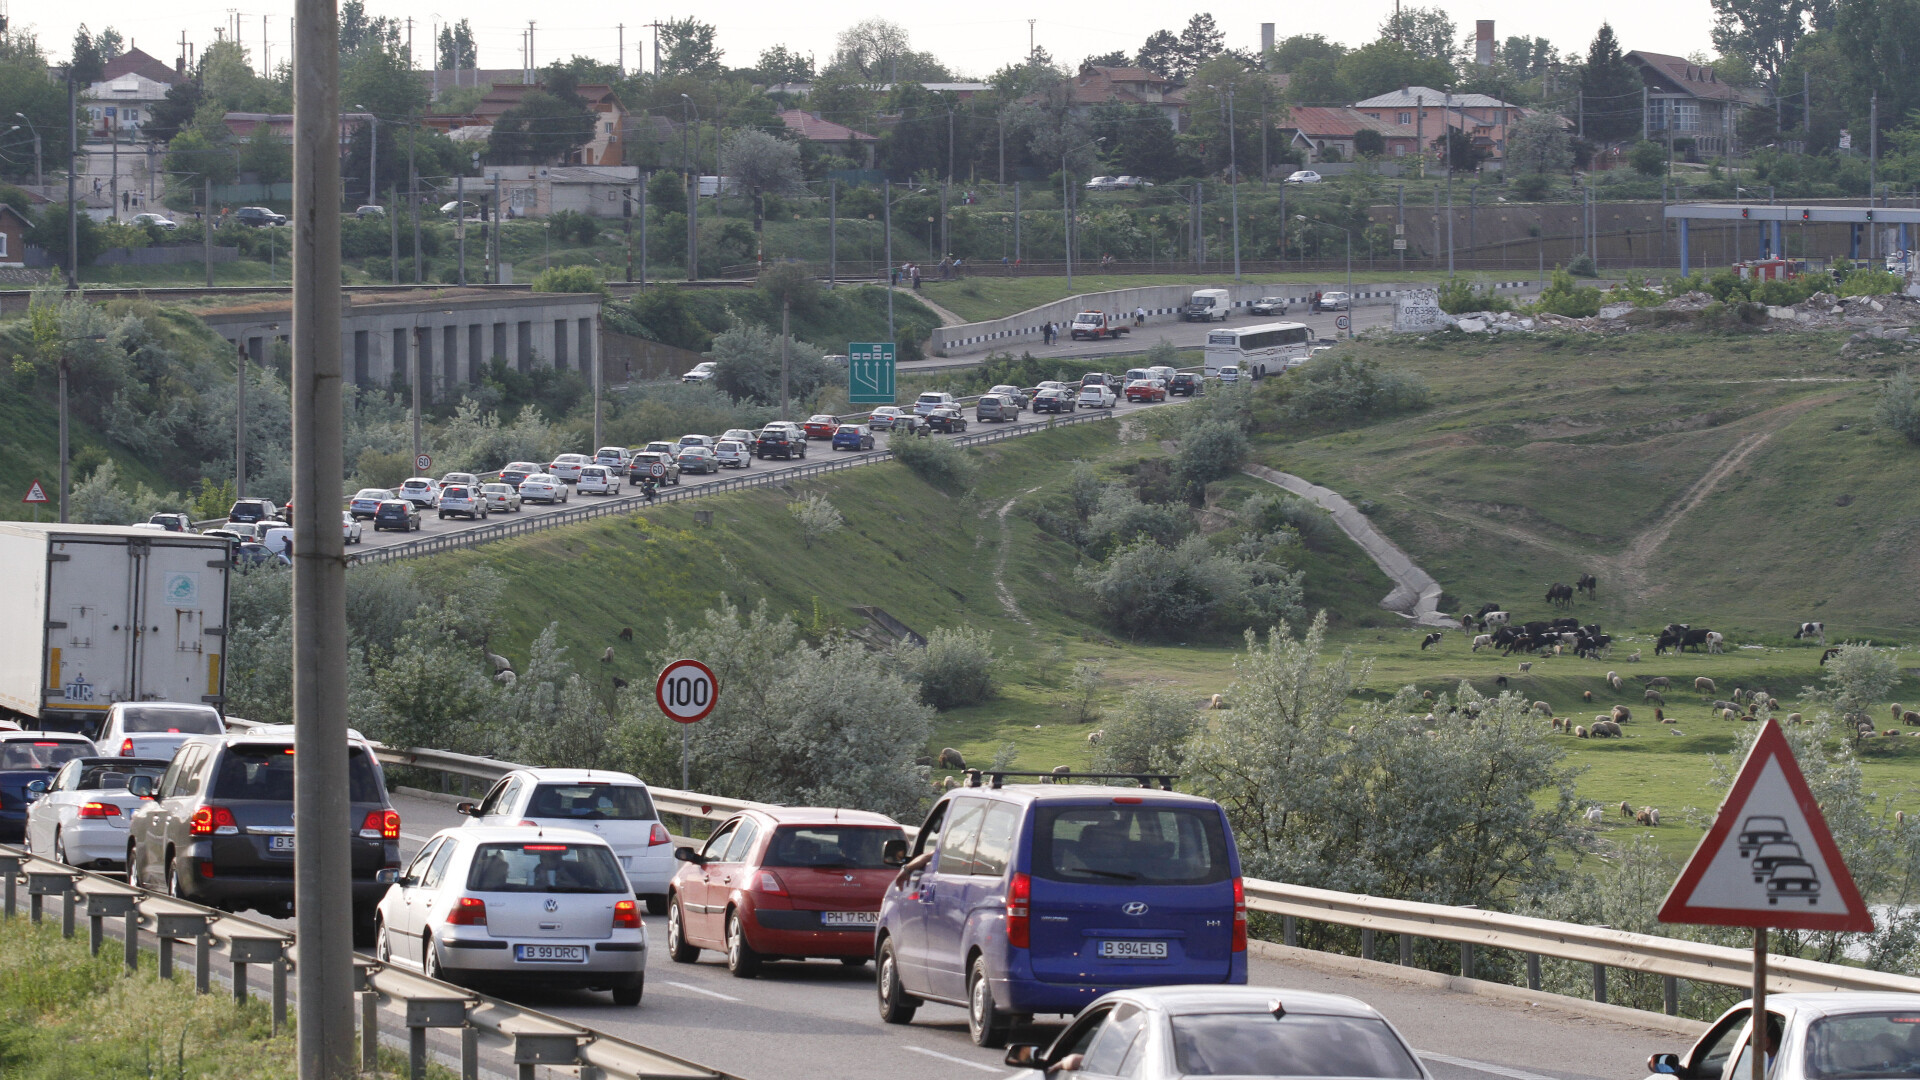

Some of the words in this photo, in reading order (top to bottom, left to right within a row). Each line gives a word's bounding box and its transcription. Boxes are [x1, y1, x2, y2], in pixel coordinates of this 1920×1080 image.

[1338, 318, 1348, 327] 40
[418, 457, 429, 467] 60
[652, 465, 663, 475] 60
[667, 677, 708, 707] 100
[276, 837, 284, 848] B
[827, 912, 843, 922] PH
[846, 912, 855, 922] 17
[857, 912, 879, 922] RUN
[527, 947, 535, 958] B
[539, 947, 552, 958] 99
[554, 947, 579, 958] DRC
[1104, 942, 1113, 954] B
[1118, 942, 1139, 954] 994
[1140, 942, 1164, 955] ELS
